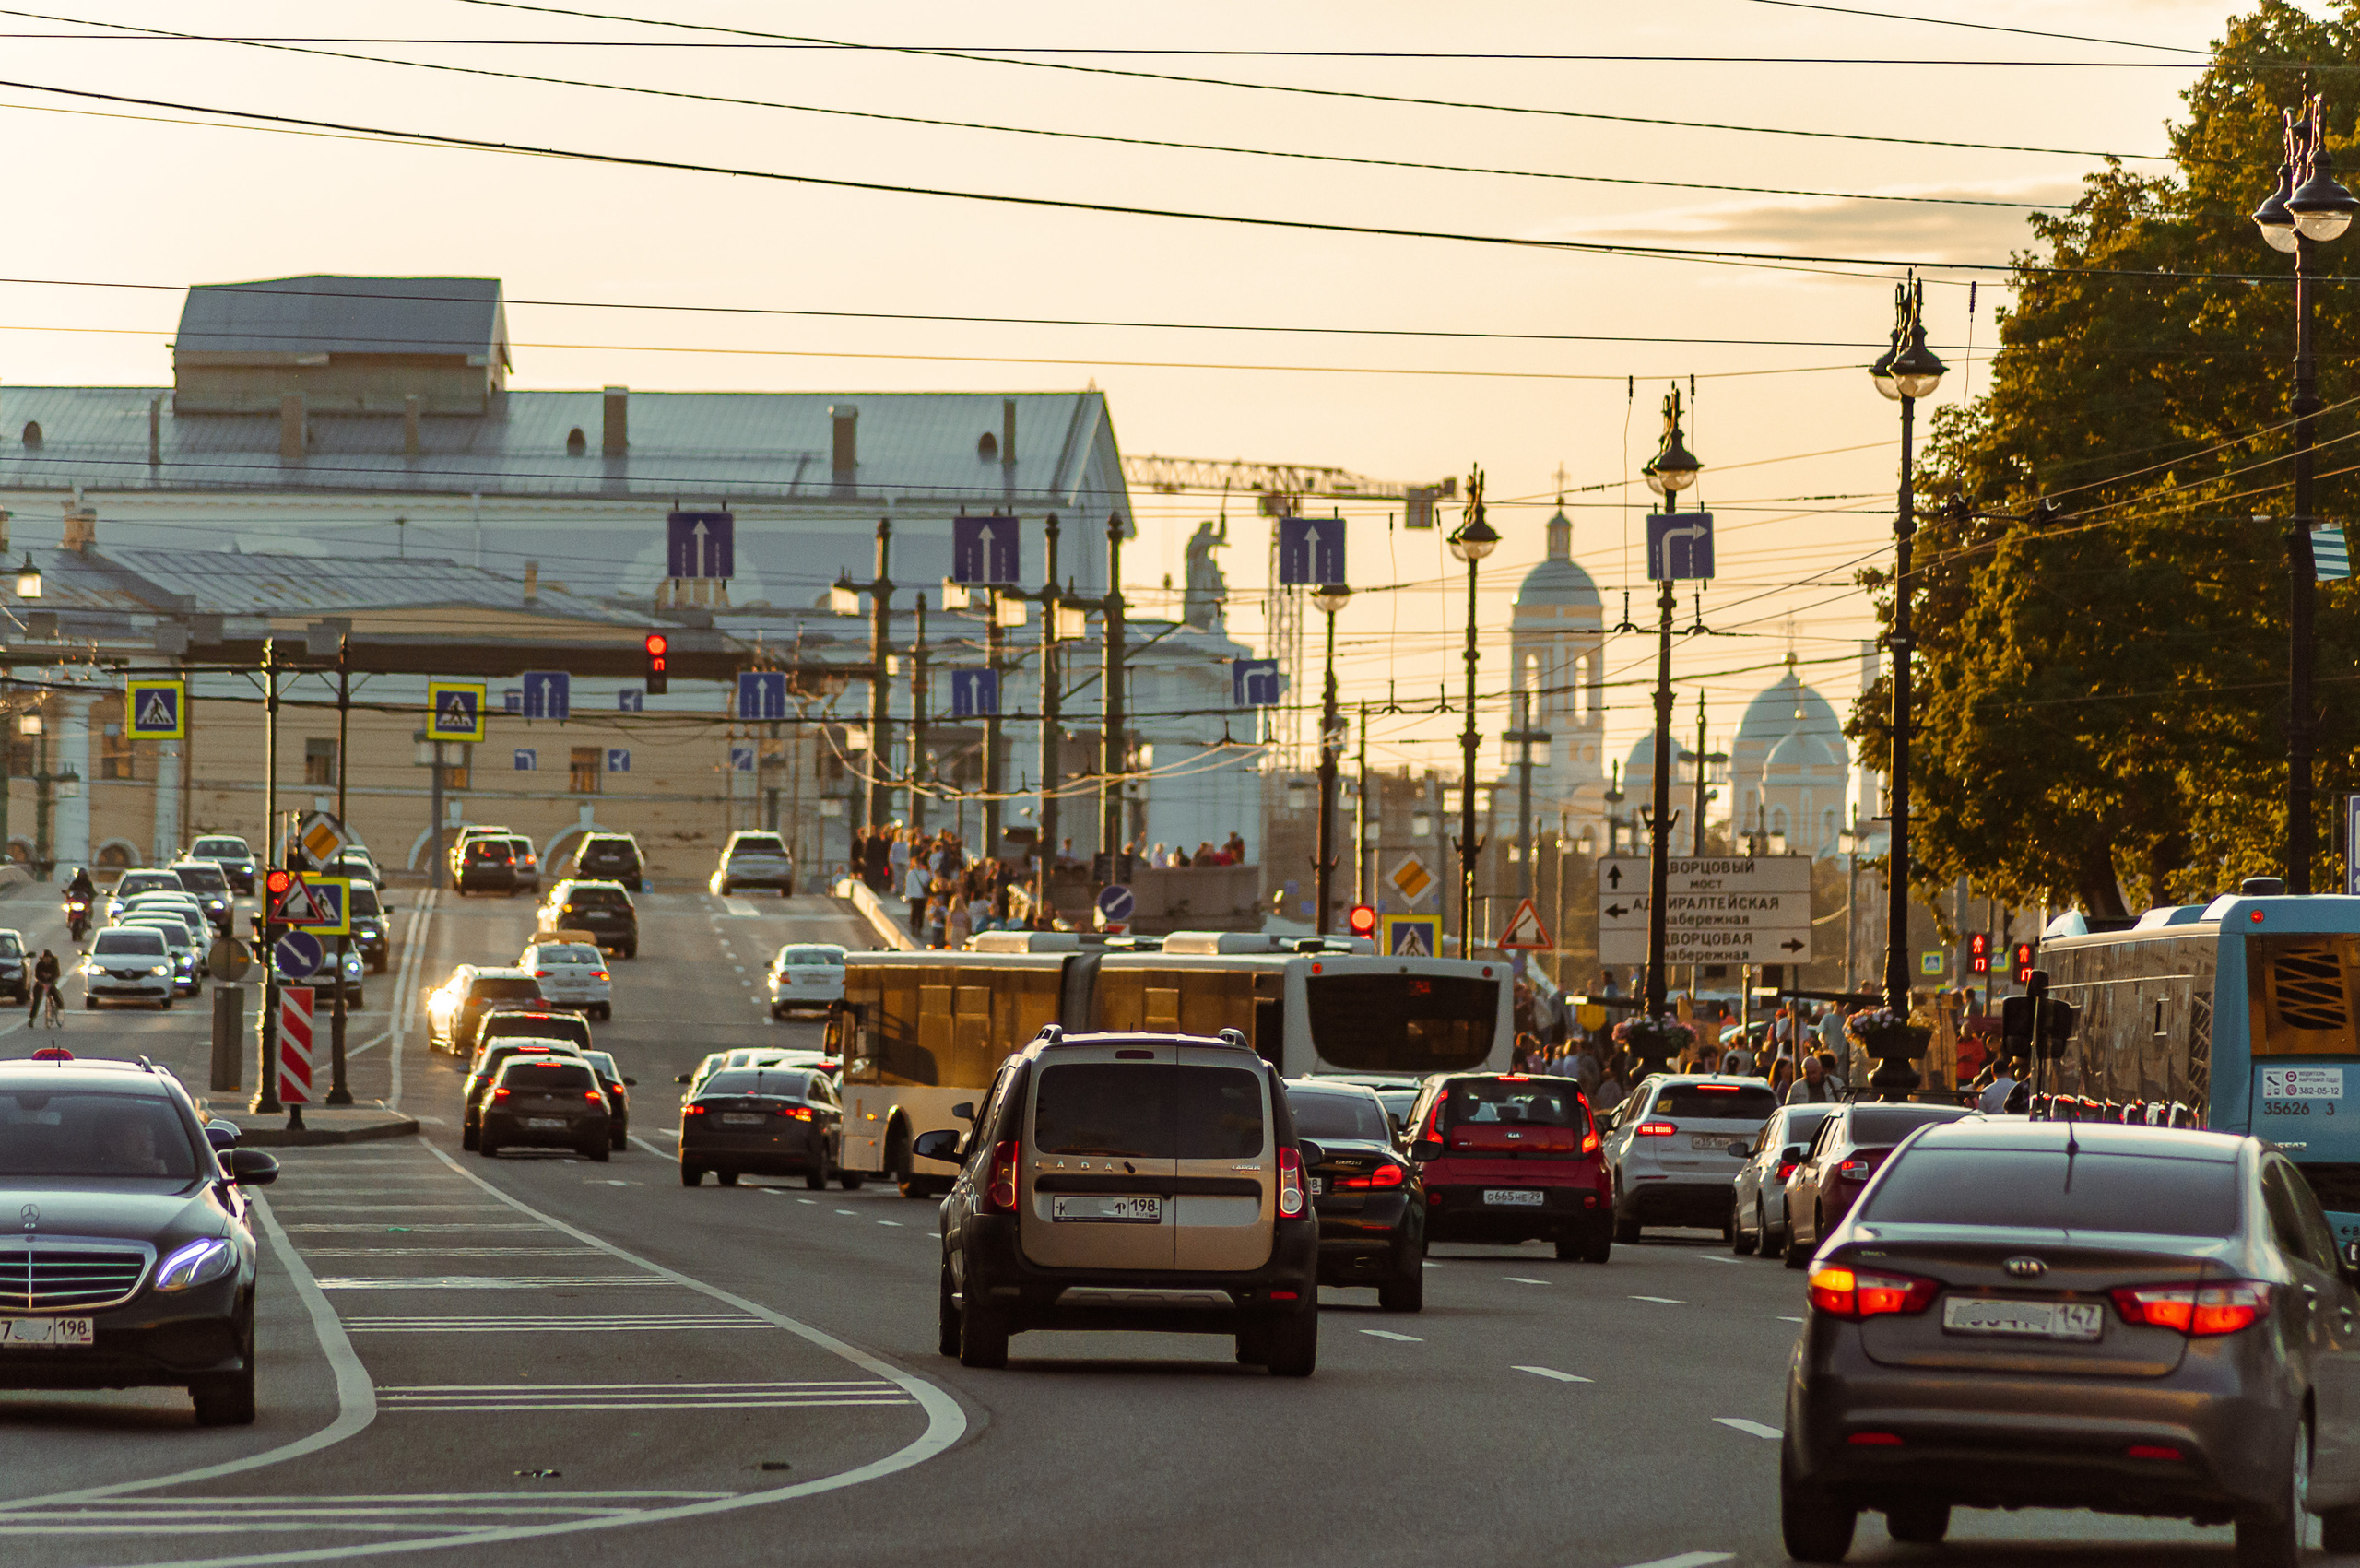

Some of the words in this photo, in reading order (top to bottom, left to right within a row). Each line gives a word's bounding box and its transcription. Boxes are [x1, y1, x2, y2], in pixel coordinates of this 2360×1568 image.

[1668, 858, 1755, 875] ВОРЦОВЫЙ
[1633, 892, 1779, 912] АИРАЛТЕЙСКАЯ
[2298, 1087, 2340, 1095] 382-05-12
[2264, 1102, 2310, 1115] 35626
[1130, 1199, 1156, 1212] 198
[58, 1319, 88, 1336] 198
